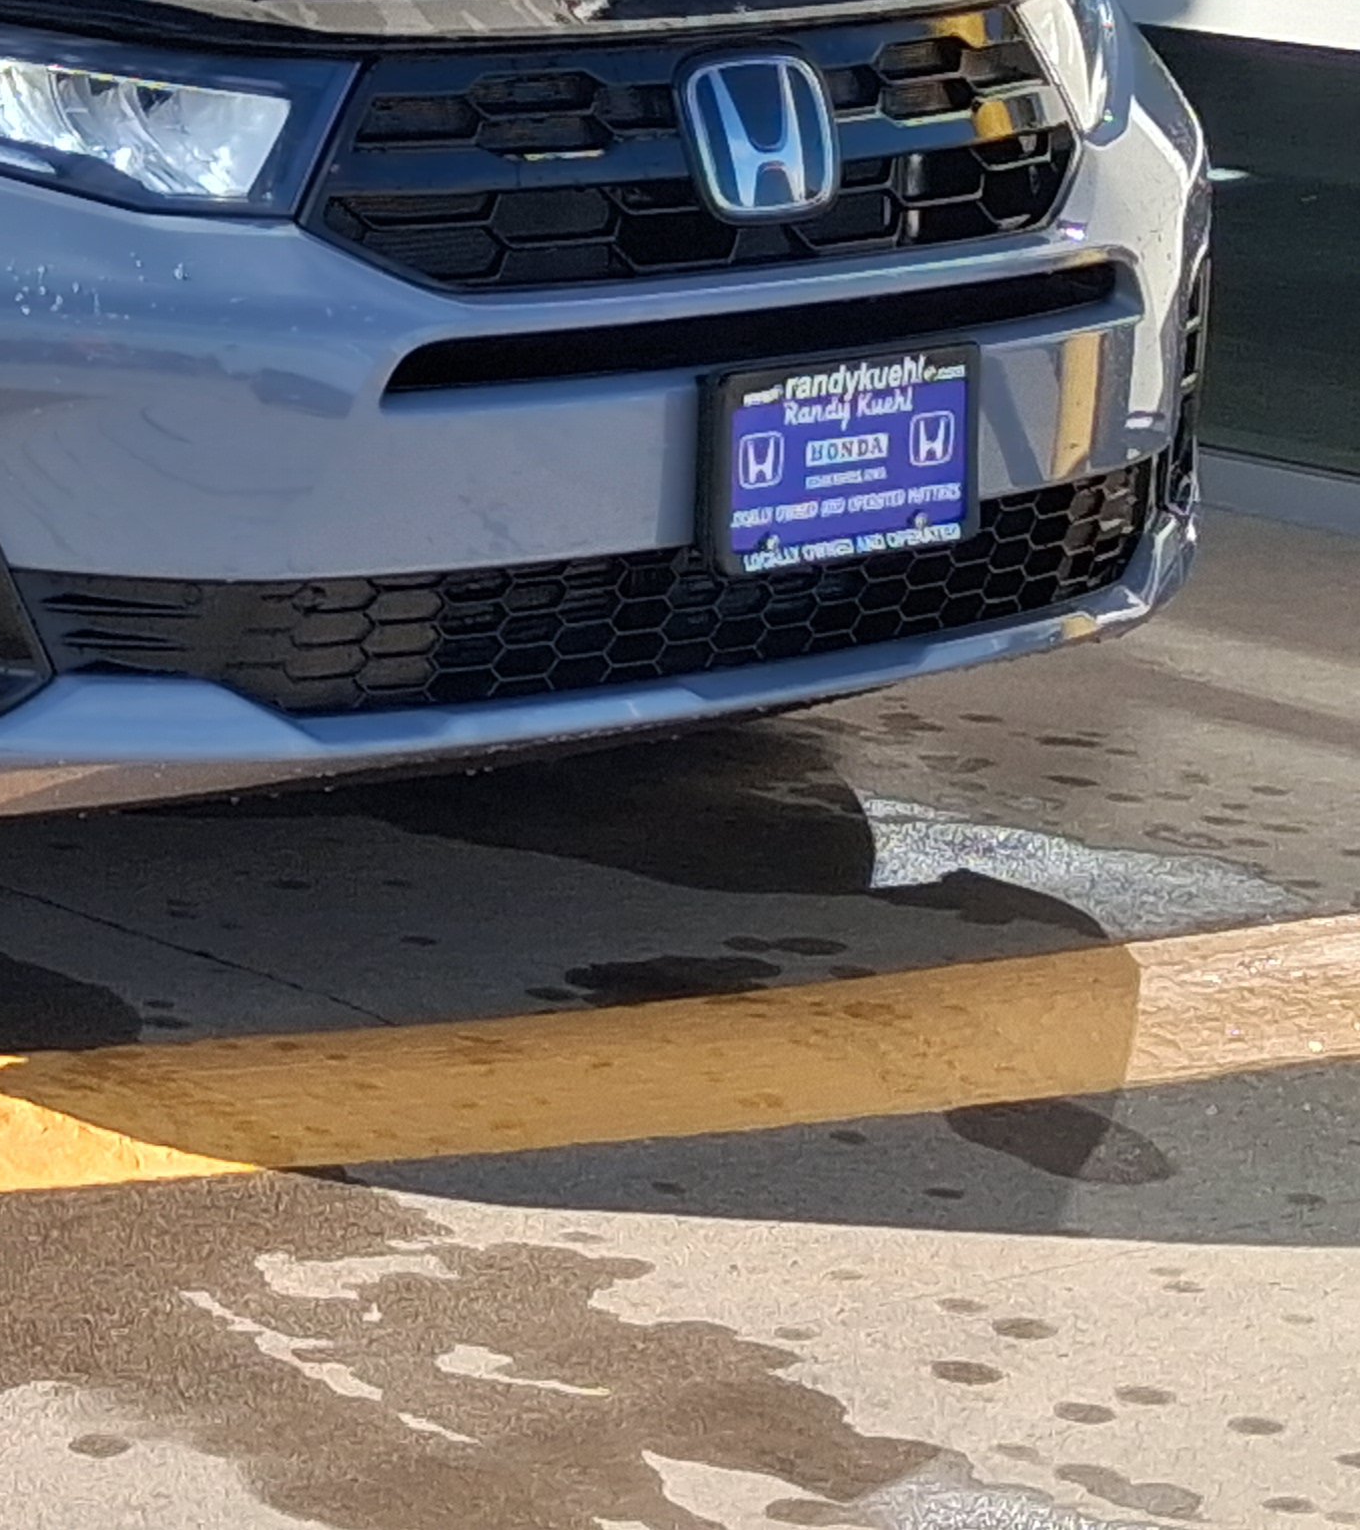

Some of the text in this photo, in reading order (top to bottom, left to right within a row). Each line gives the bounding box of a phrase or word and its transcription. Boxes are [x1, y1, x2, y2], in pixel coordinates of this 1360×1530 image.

[783, 386, 913, 432] Randy Kuehl
[809, 436, 885, 463] HONDA
